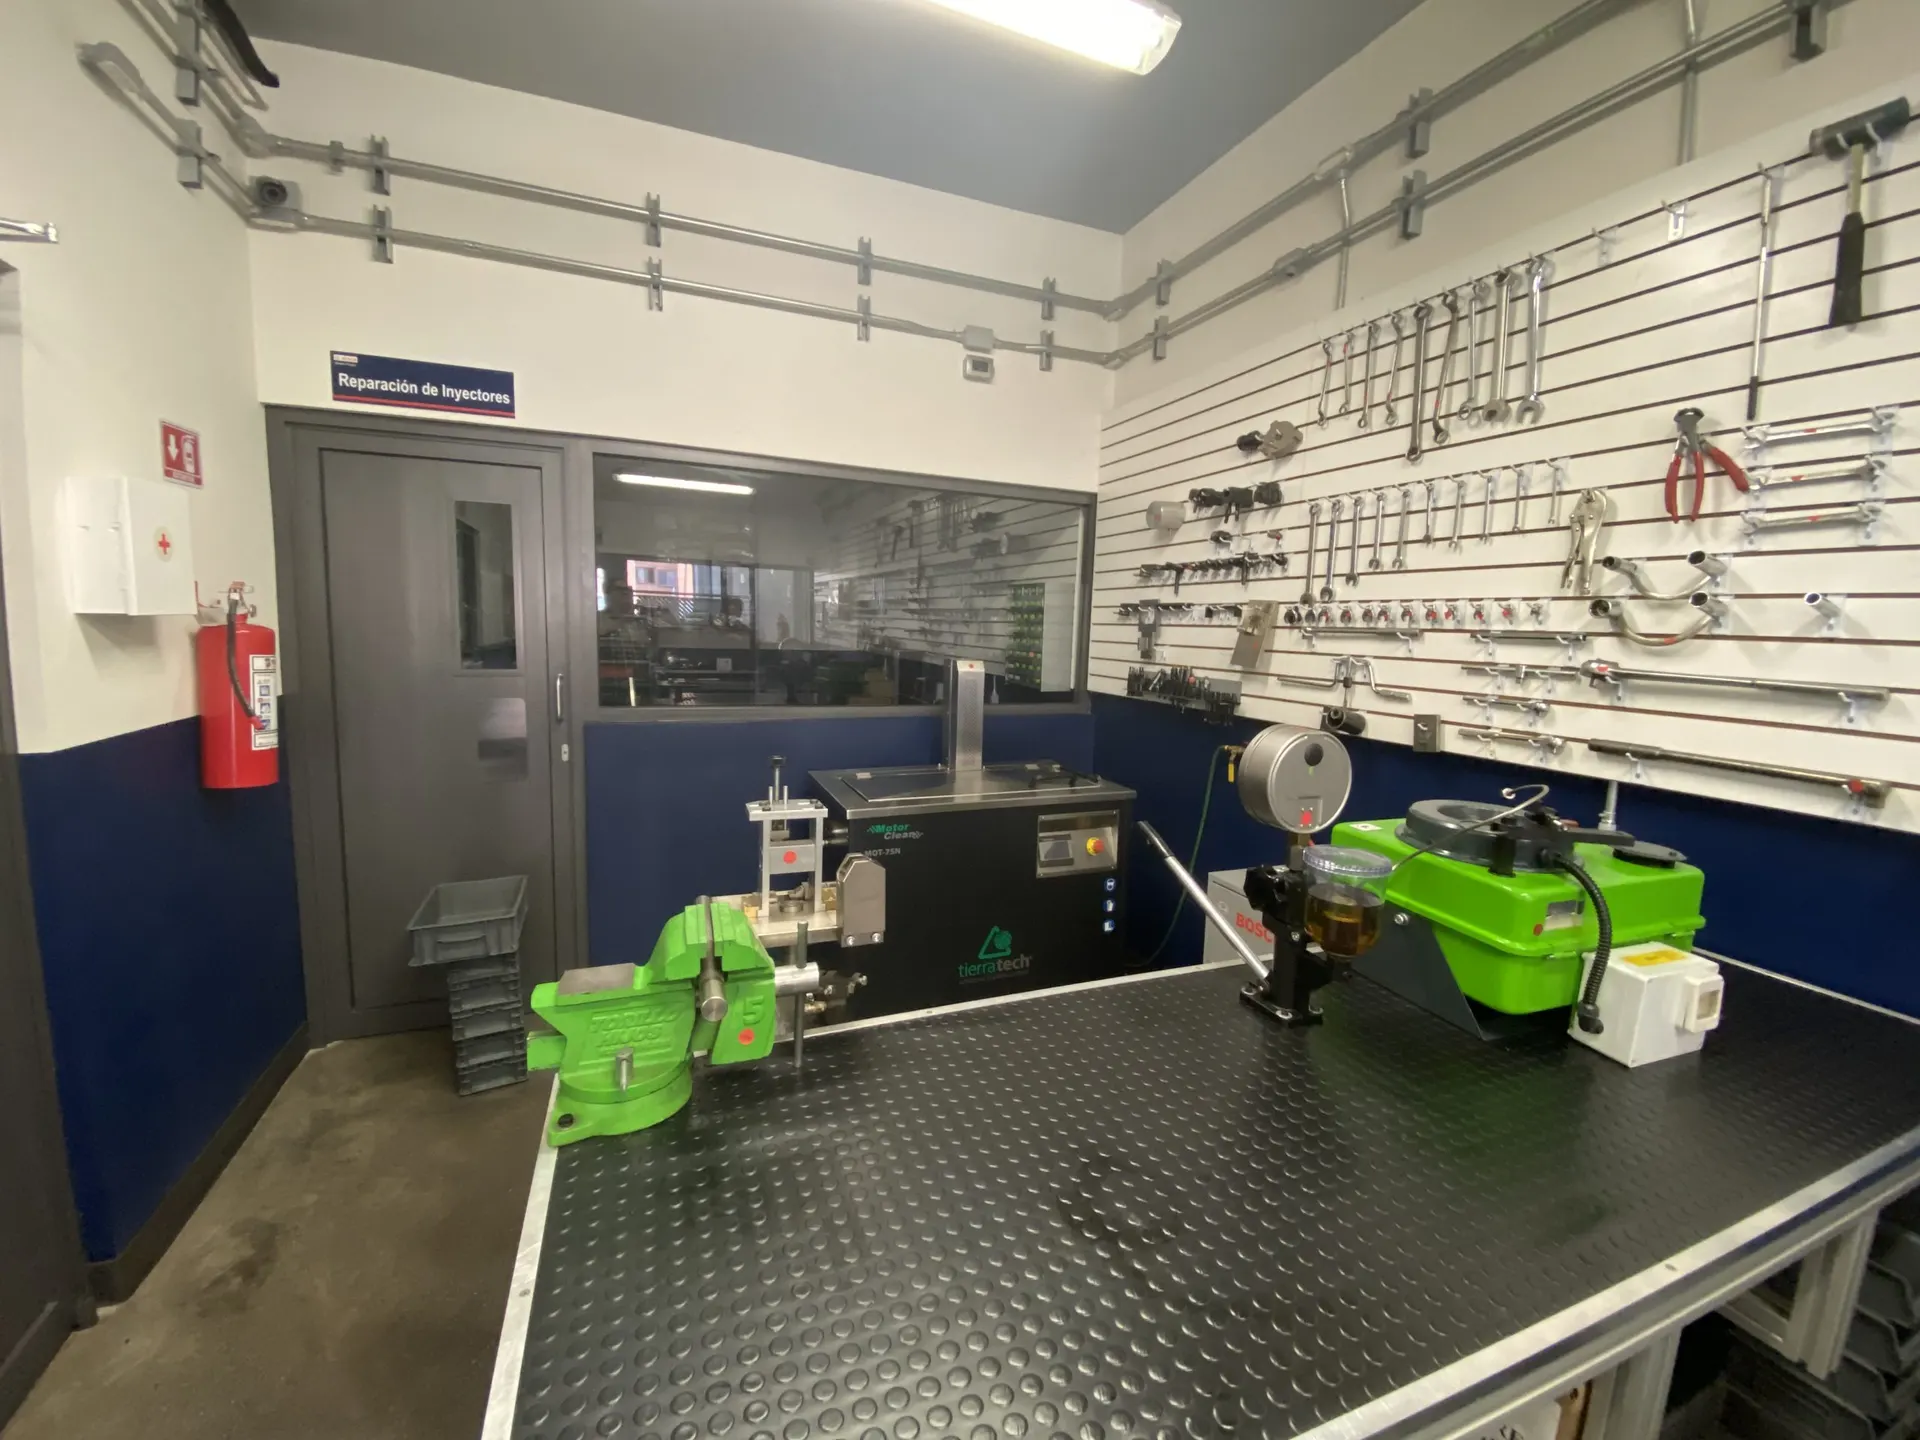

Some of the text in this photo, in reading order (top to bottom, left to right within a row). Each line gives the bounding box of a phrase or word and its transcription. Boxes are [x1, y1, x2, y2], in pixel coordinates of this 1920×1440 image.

[338, 372, 511, 405] Reparación de Inyectores
[873, 824, 910, 833] Motor
[1236, 912, 1273, 944] BOSC
[958, 953, 1030, 977] tierratech
[742, 995, 766, 1025] 5
